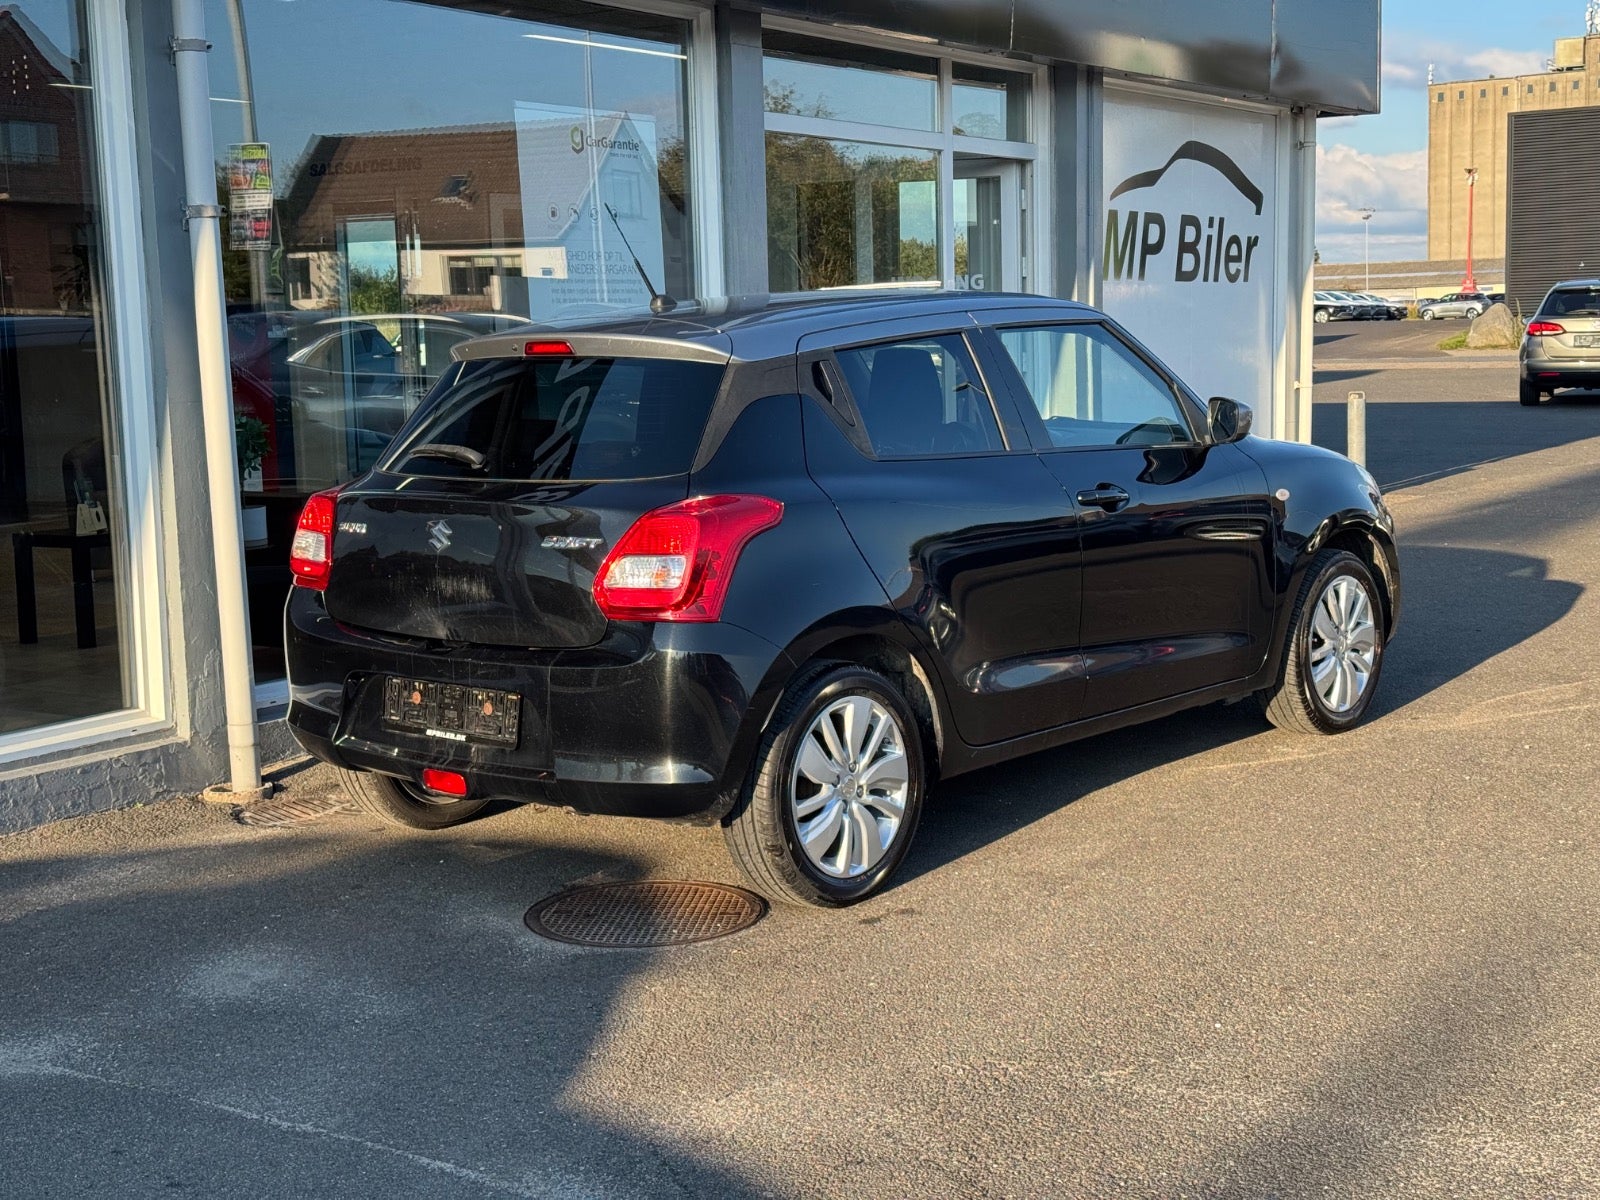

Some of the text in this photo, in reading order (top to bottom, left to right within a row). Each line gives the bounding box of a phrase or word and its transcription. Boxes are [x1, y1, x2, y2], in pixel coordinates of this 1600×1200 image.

[585, 135, 640, 152] CarGarantie
[1103, 209, 1259, 283] MP Biler
